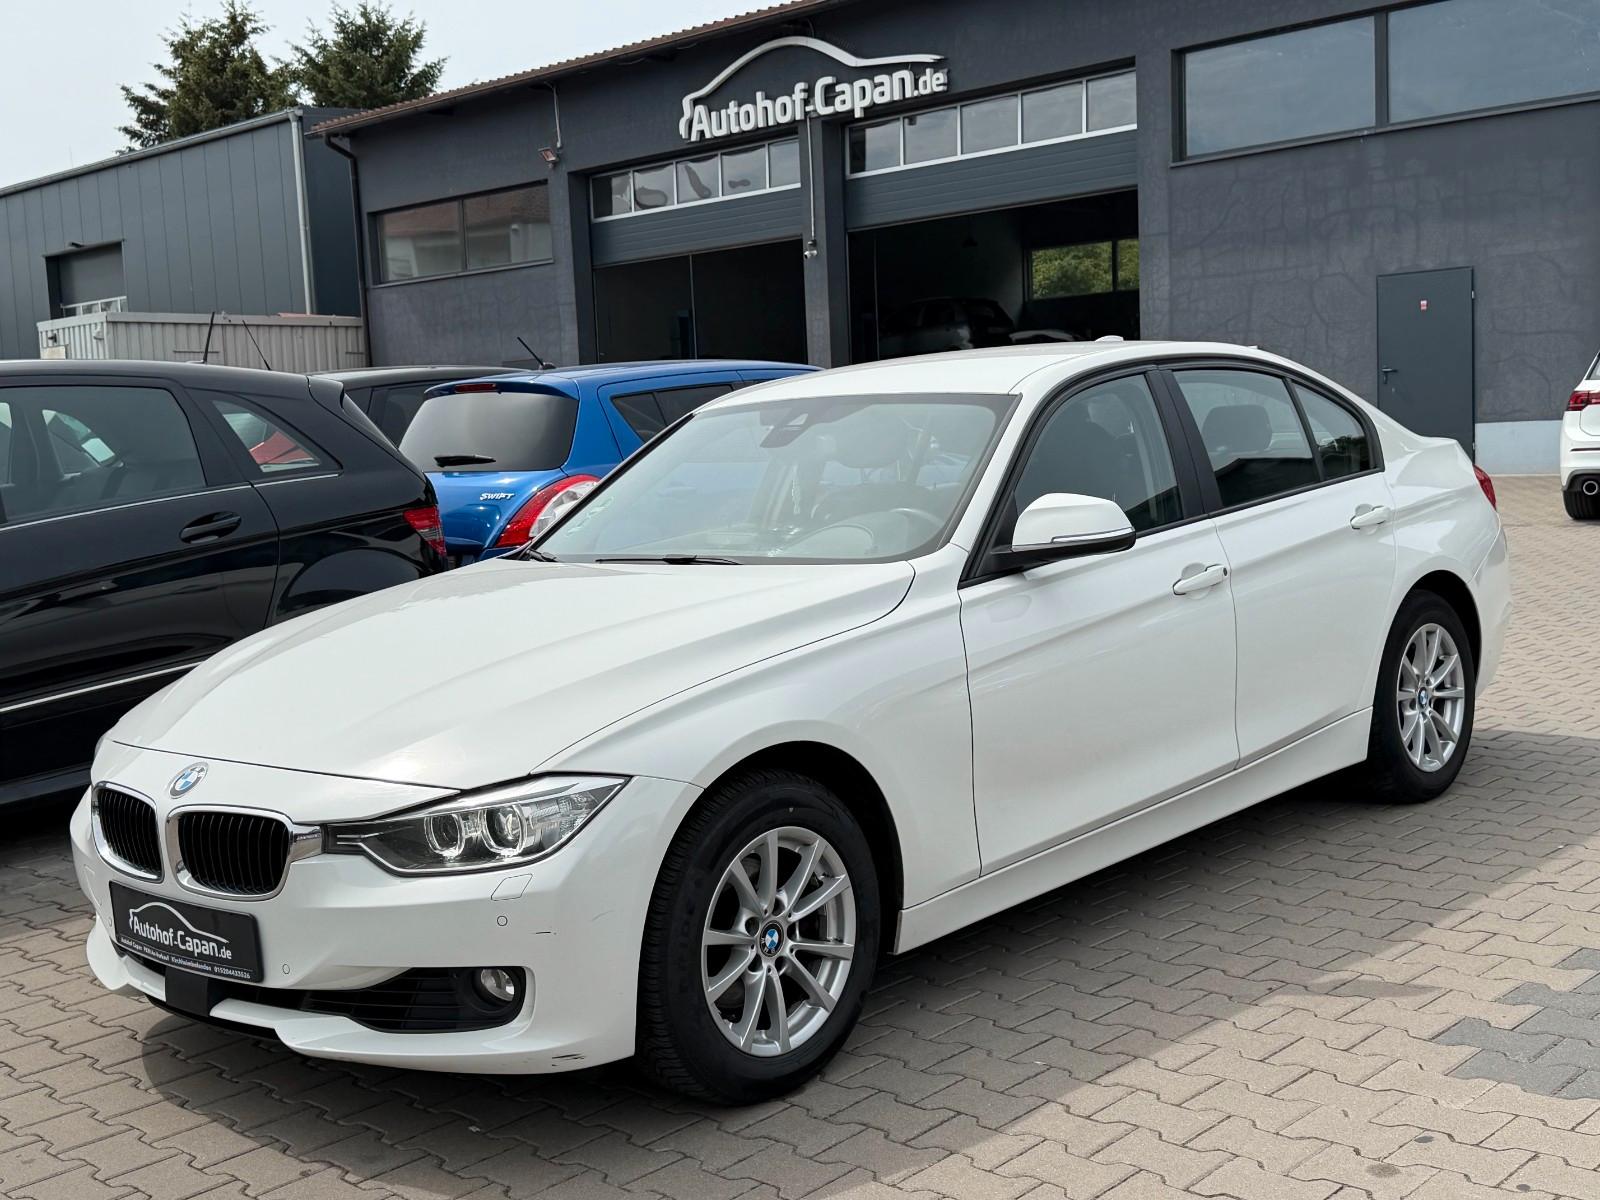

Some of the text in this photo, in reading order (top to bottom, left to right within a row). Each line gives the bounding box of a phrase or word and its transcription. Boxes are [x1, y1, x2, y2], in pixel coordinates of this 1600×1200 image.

[690, 68, 948, 141] Autohof-Capan.de
[480, 492, 515, 501] SWIFT
[133, 916, 232, 960] Autohof-Capan.de
